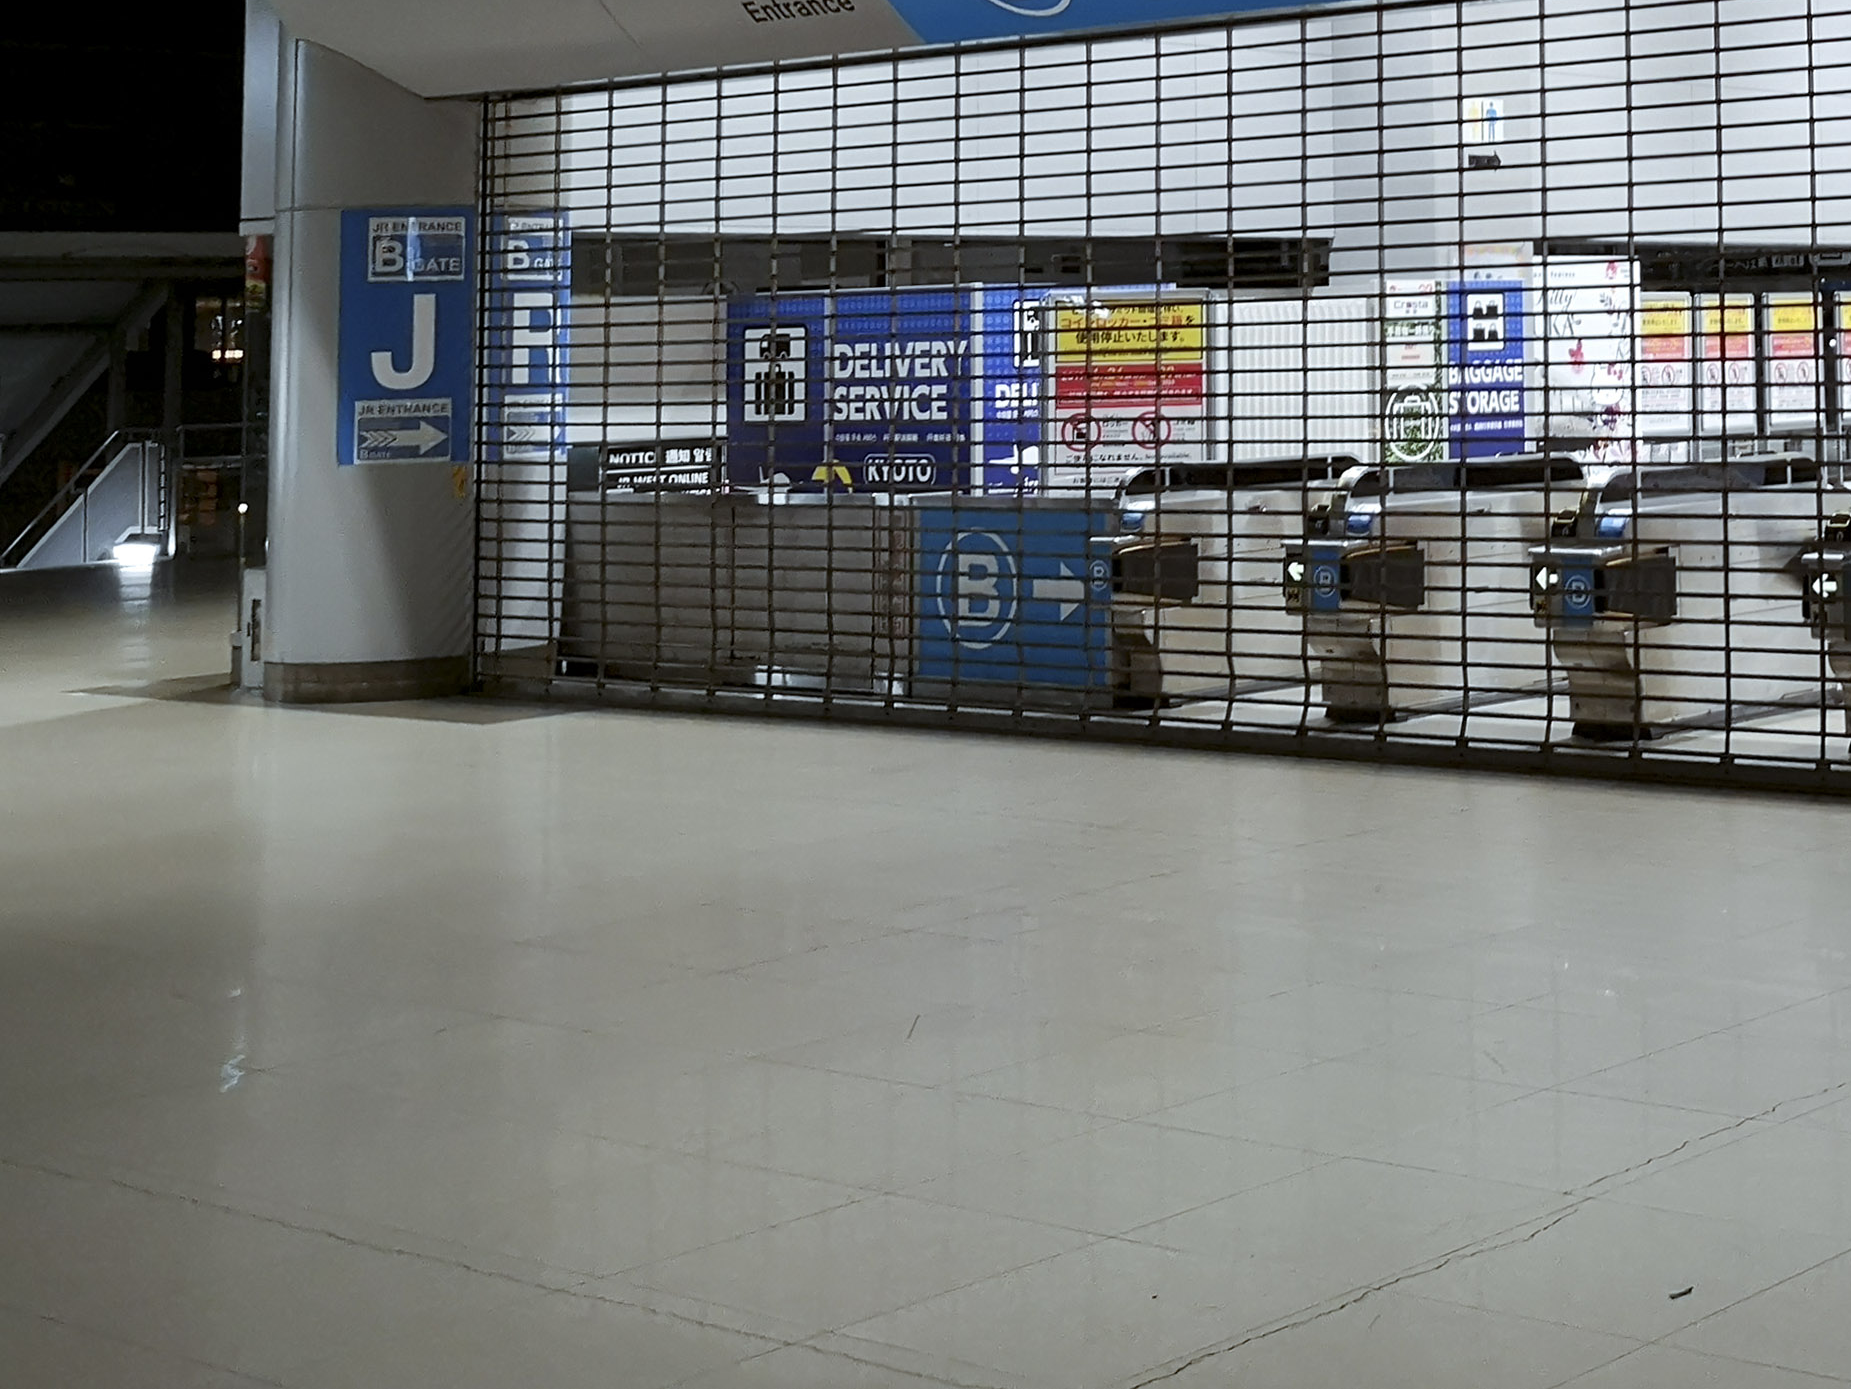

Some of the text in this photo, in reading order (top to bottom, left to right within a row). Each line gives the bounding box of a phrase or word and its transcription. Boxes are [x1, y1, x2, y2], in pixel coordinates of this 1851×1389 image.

[393, 220, 463, 233] ENRANCE
[834, 340, 968, 379] DELIVERY
[834, 384, 948, 421] SERVICE
[609, 452, 660, 464] NOTIC
[867, 458, 932, 483] KYOTO
[957, 553, 1001, 627] B
